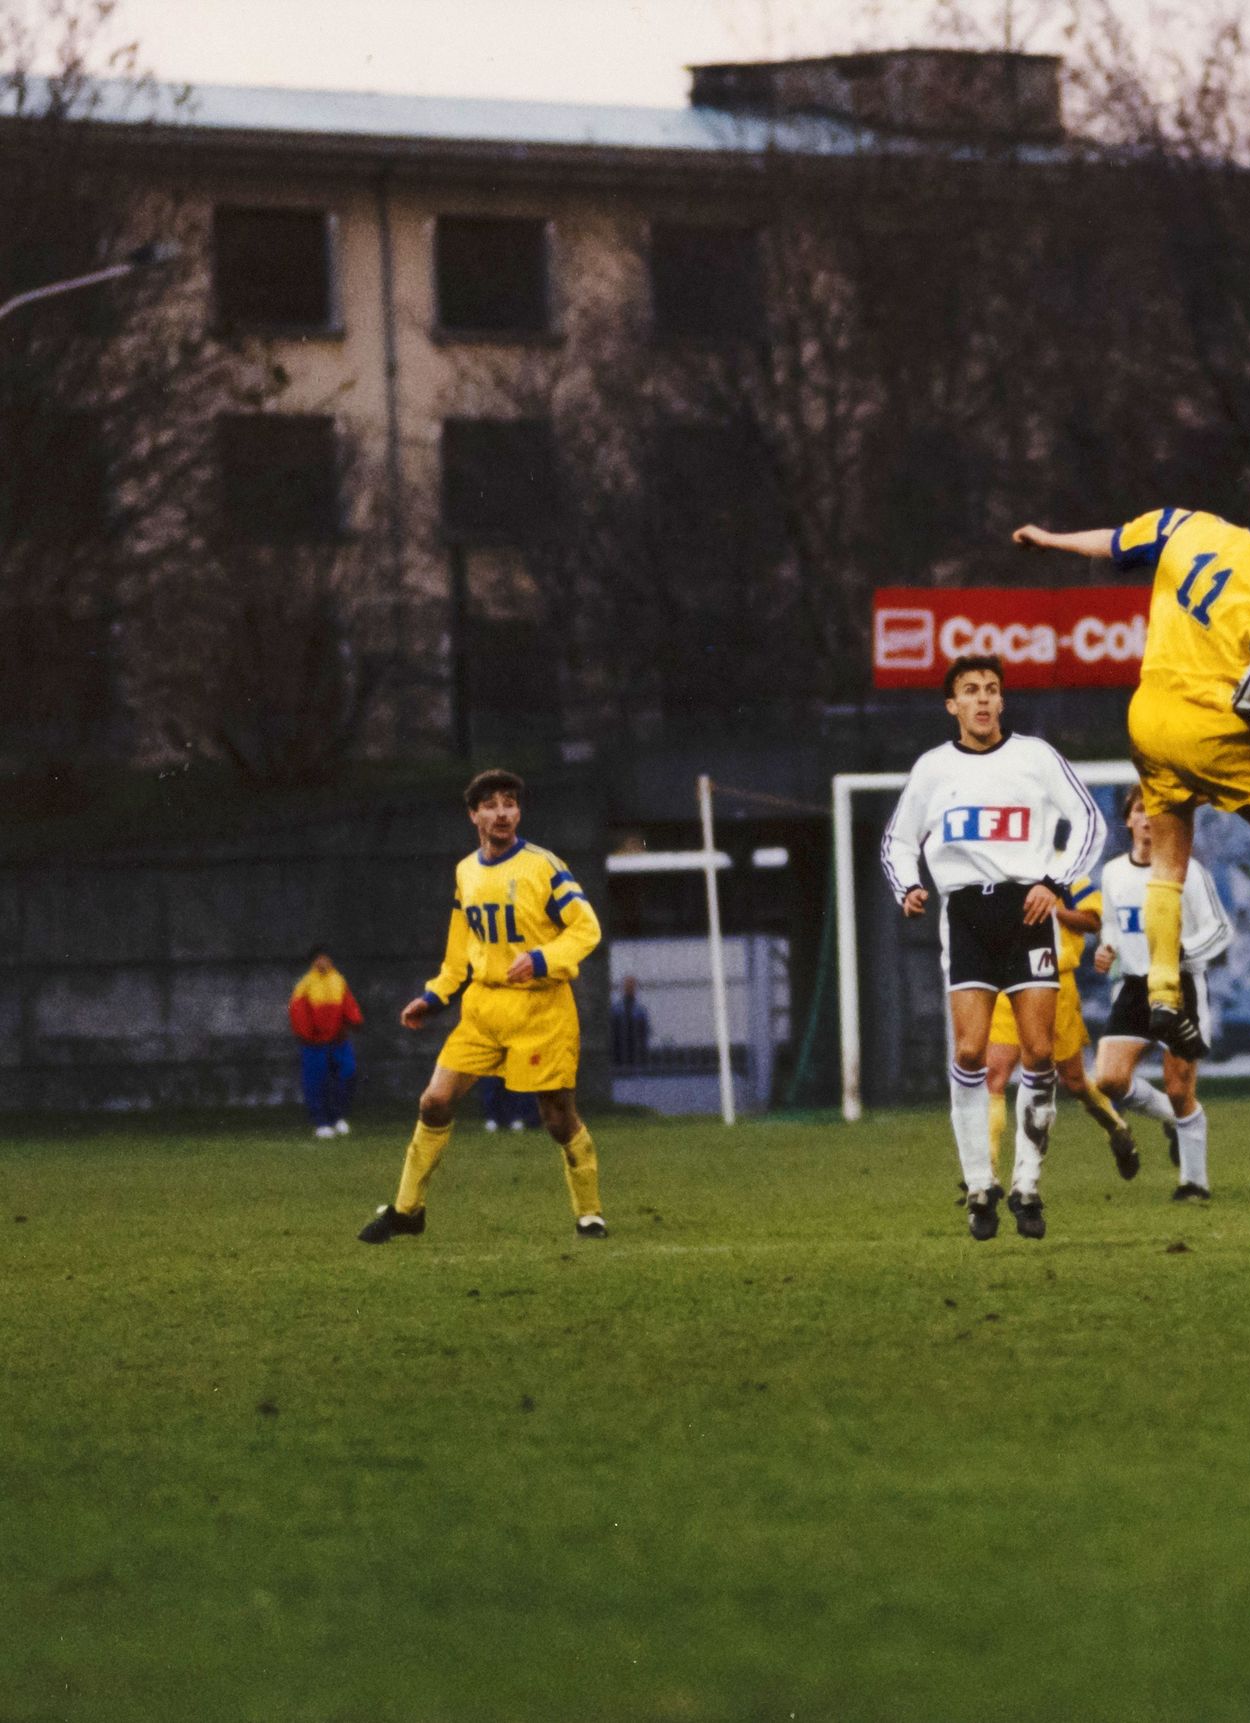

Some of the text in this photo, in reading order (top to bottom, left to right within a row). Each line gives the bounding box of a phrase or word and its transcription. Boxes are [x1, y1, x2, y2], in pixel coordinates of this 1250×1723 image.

[1176, 552, 1233, 629] 11
[939, 613, 1147, 663] Coca-Col
[946, 808, 1023, 839] TF1
[466, 903, 525, 944] RTL
